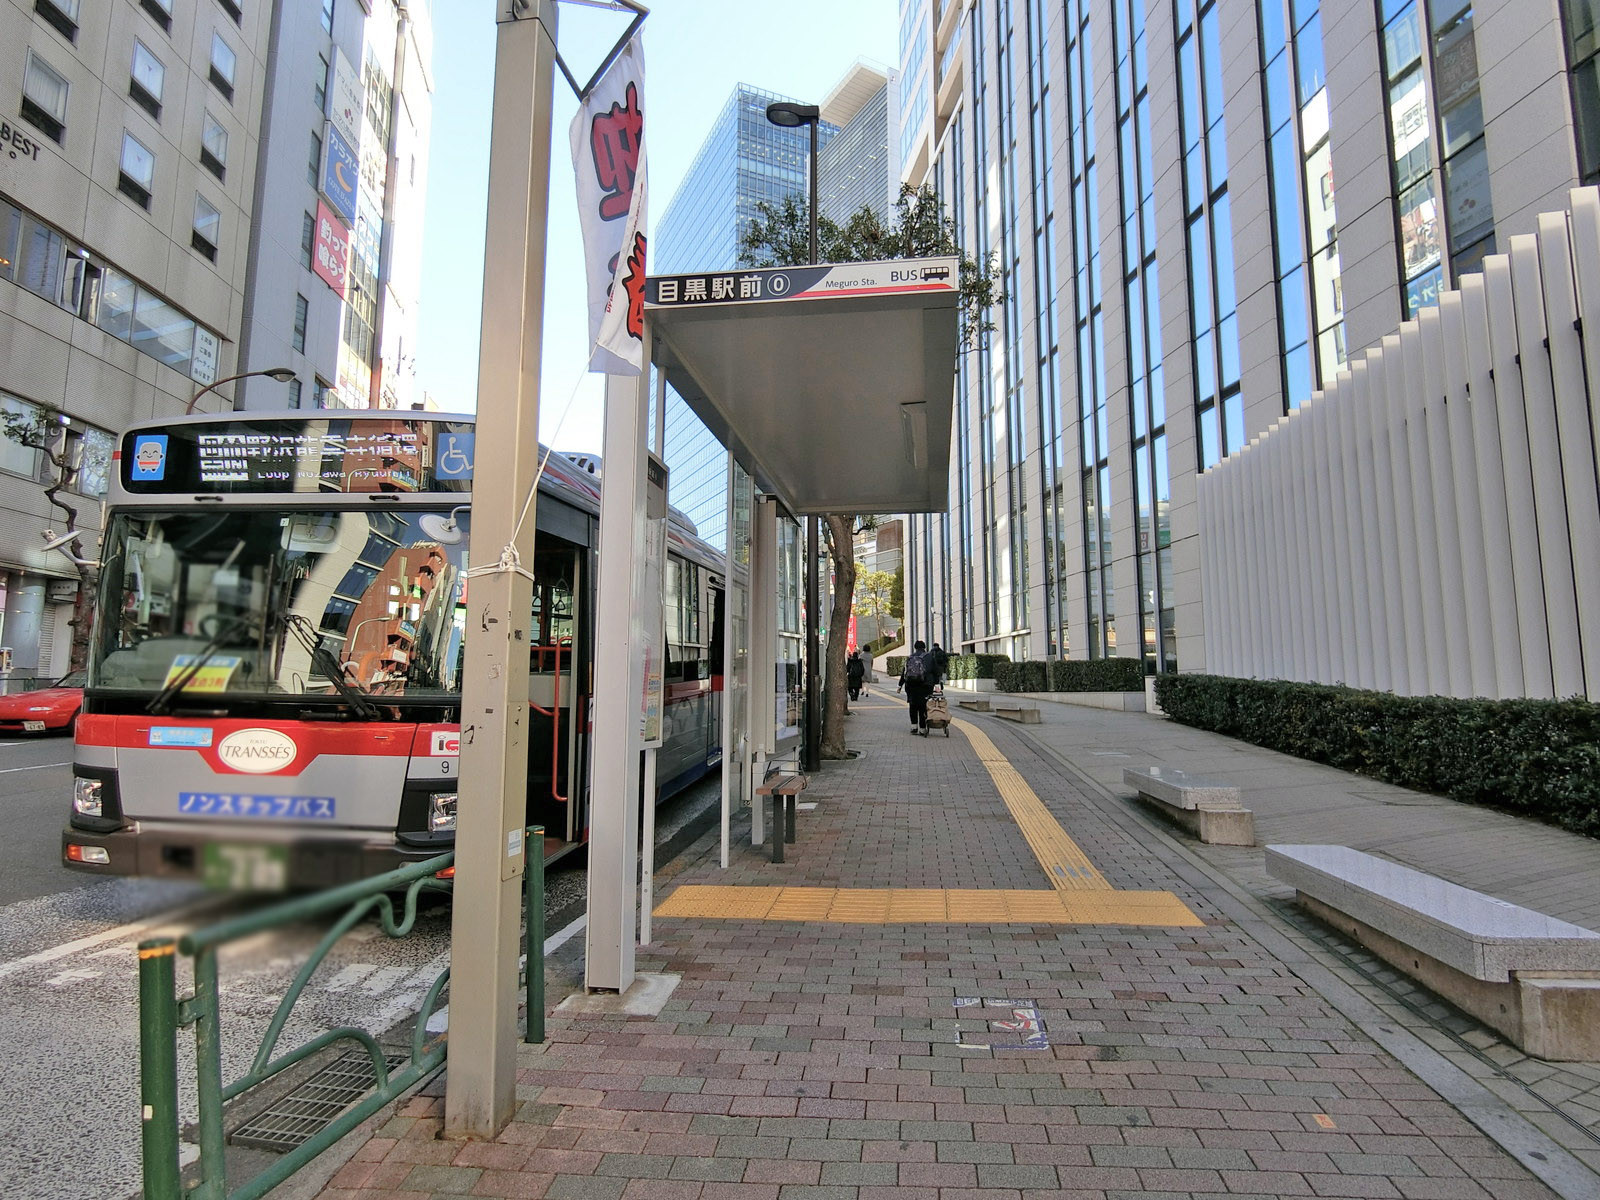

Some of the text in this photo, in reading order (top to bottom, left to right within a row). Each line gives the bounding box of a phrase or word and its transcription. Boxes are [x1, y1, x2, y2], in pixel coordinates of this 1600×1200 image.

[1, 122, 40, 161] BEST
[320, 217, 348, 261] 釣って
[825, 277, 878, 290] Meguro Sta.
[890, 269, 918, 283] BUS
[658, 275, 763, 303] 目黒駅前
[224, 743, 291, 759] TRANSSÉS
[441, 760, 450, 774] 9
[181, 794, 332, 817] ノンステップバス
